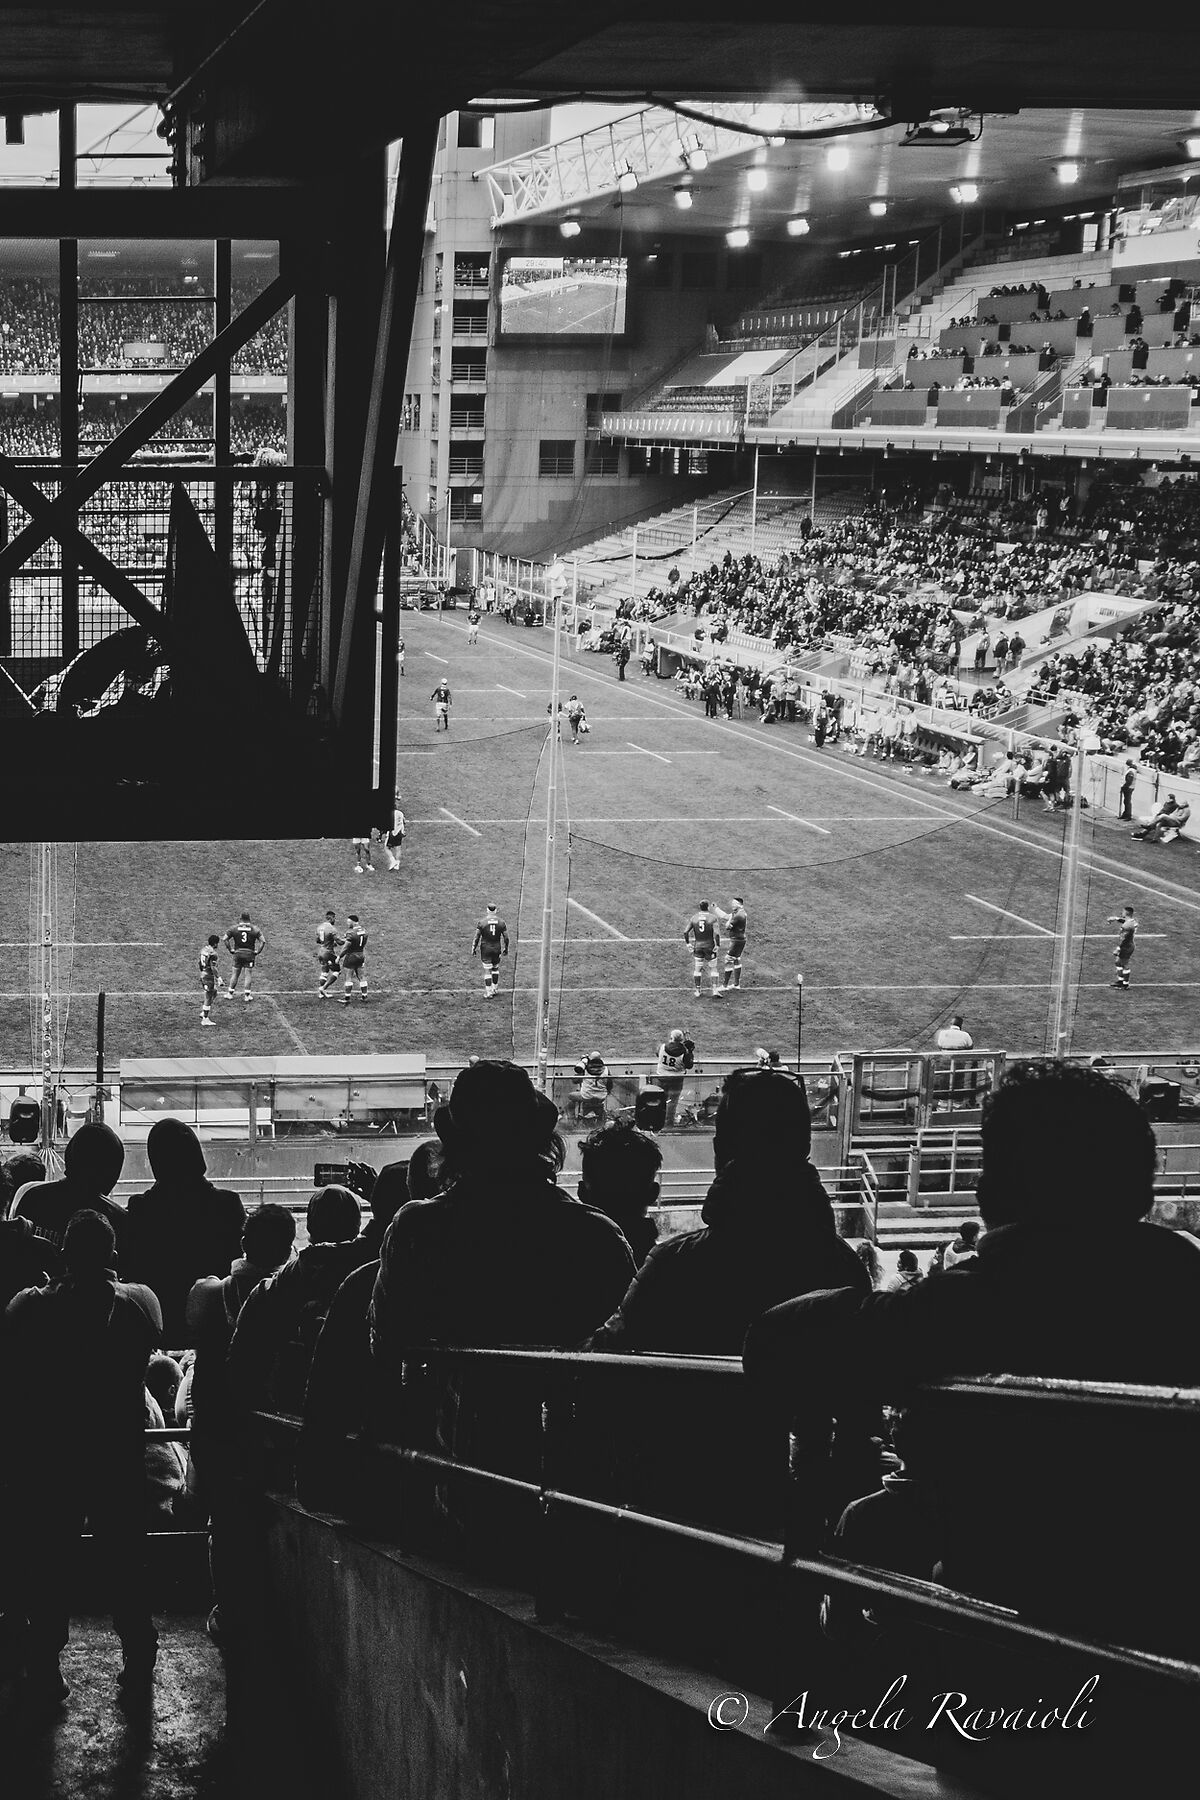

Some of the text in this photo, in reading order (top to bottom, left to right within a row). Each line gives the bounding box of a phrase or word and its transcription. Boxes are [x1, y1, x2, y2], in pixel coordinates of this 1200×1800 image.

[489, 924, 496, 936] 4
[241, 931, 247, 943] 3
[661, 1055, 677, 1067] 18
